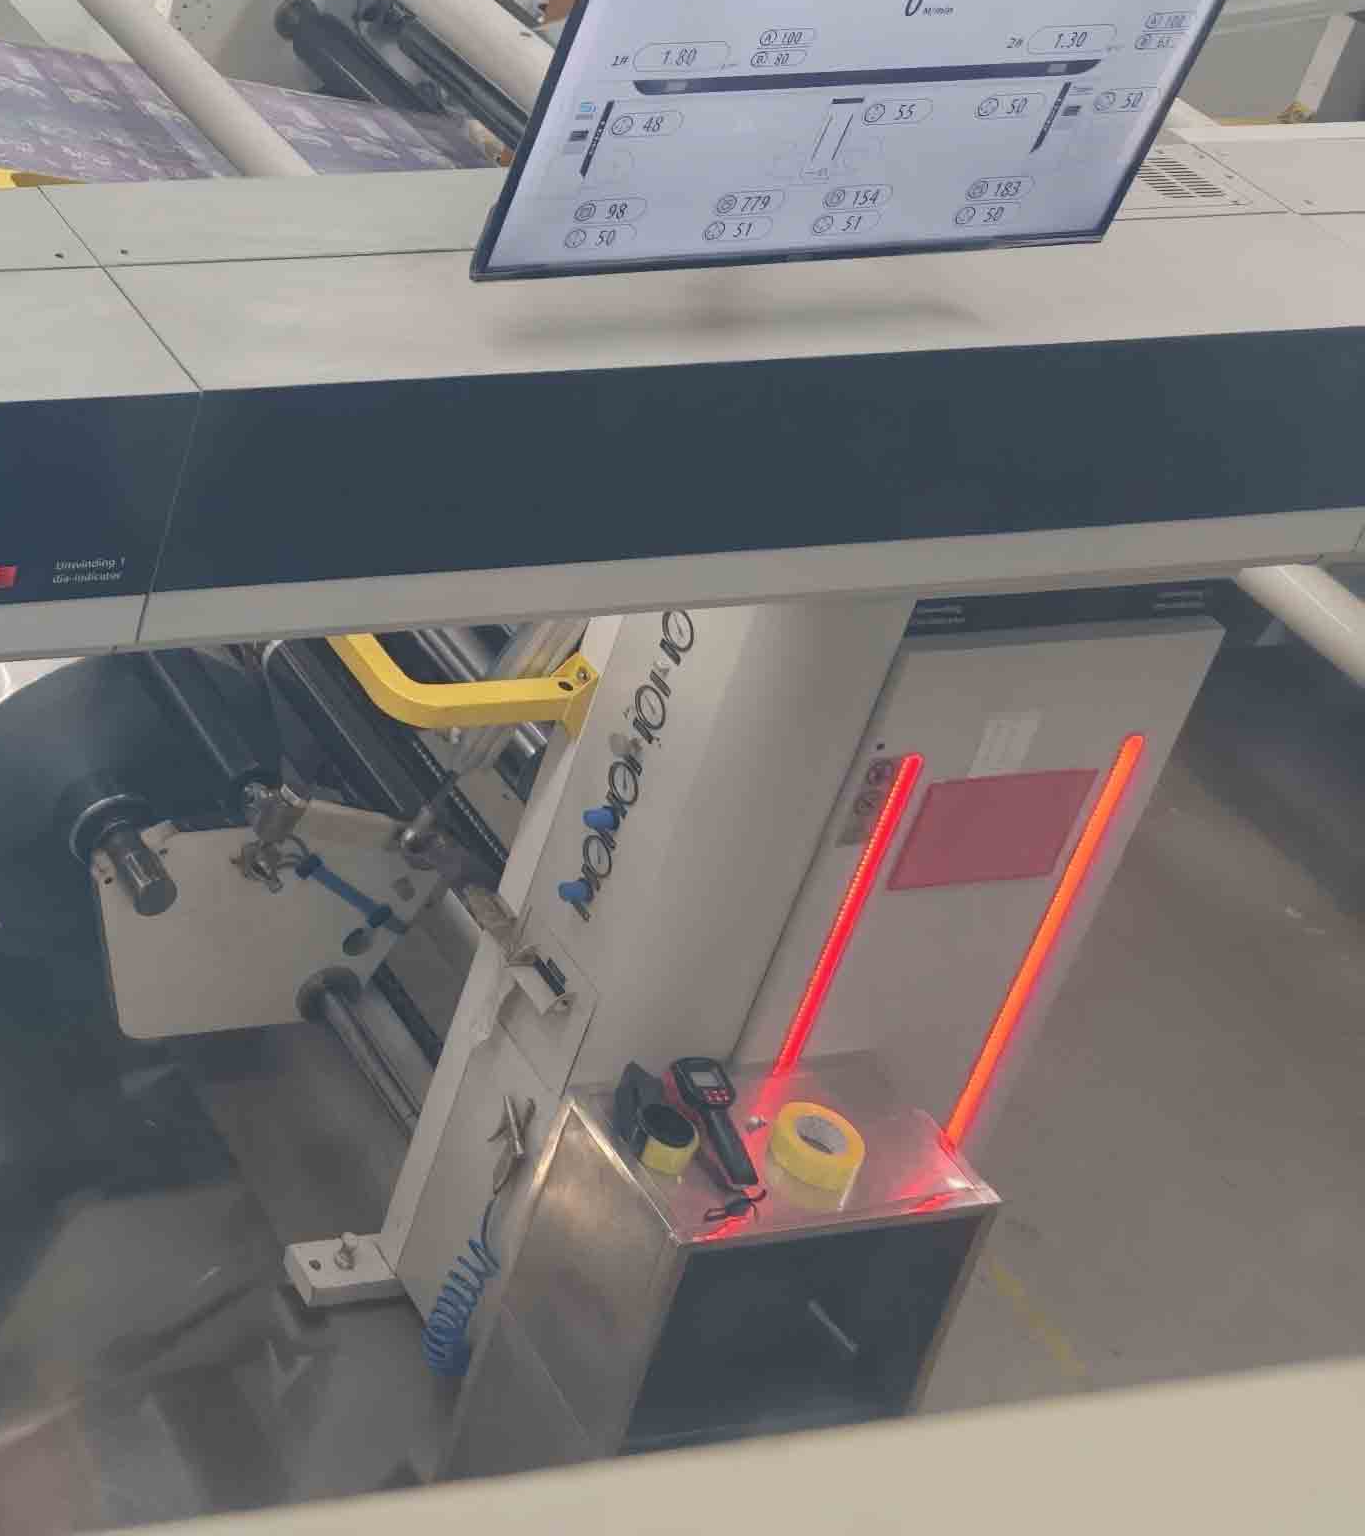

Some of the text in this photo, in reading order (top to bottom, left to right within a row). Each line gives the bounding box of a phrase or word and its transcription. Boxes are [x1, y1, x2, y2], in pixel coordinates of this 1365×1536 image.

[781, 31, 803, 45] 100
[893, 103, 916, 121] 55
[1006, 97, 1029, 115] 50
[642, 115, 664, 133] 48
[740, 195, 771, 213] 779
[852, 189, 880, 207] 154
[606, 202, 628, 221] 98
[733, 221, 753, 239] 51
[841, 215, 862, 233] 51
[595, 228, 617, 247] 50
